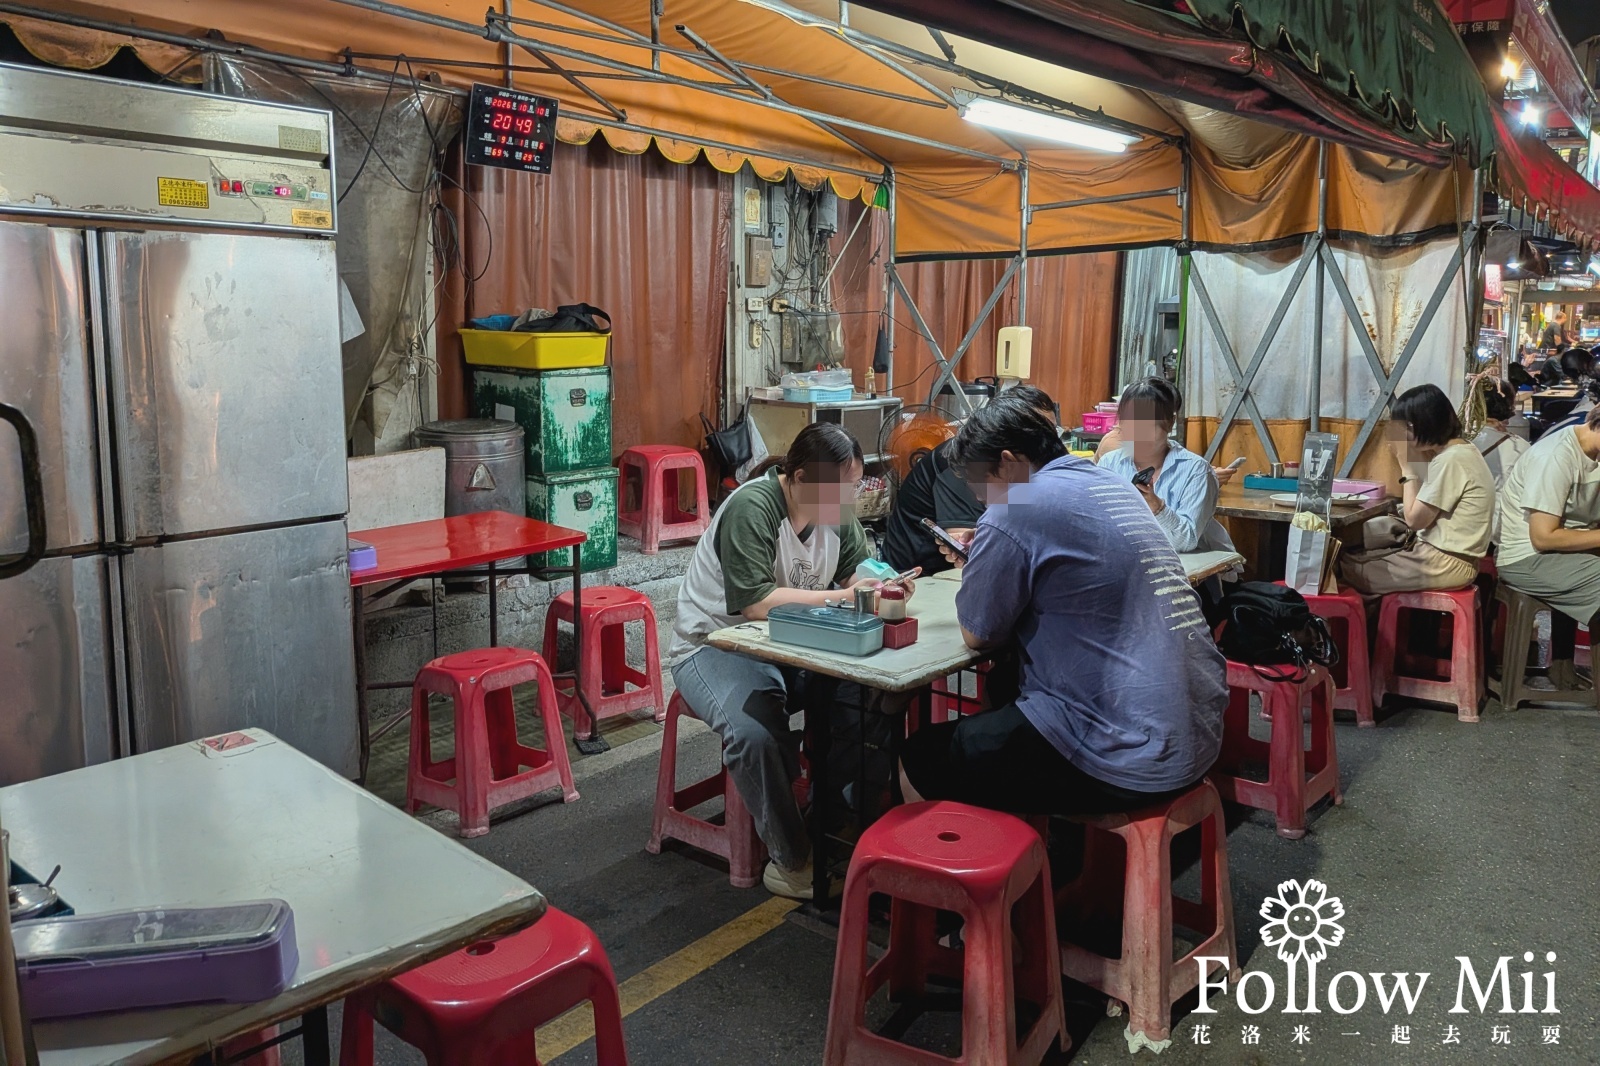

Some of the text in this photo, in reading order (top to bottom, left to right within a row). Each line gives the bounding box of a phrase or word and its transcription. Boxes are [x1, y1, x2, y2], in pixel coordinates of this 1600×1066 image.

[1456, 20, 1500, 35] 有保障
[492, 99, 511, 108] 2026
[536, 107, 545, 115] 10
[492, 148, 502, 156] 69
[523, 153, 533, 161] 29
